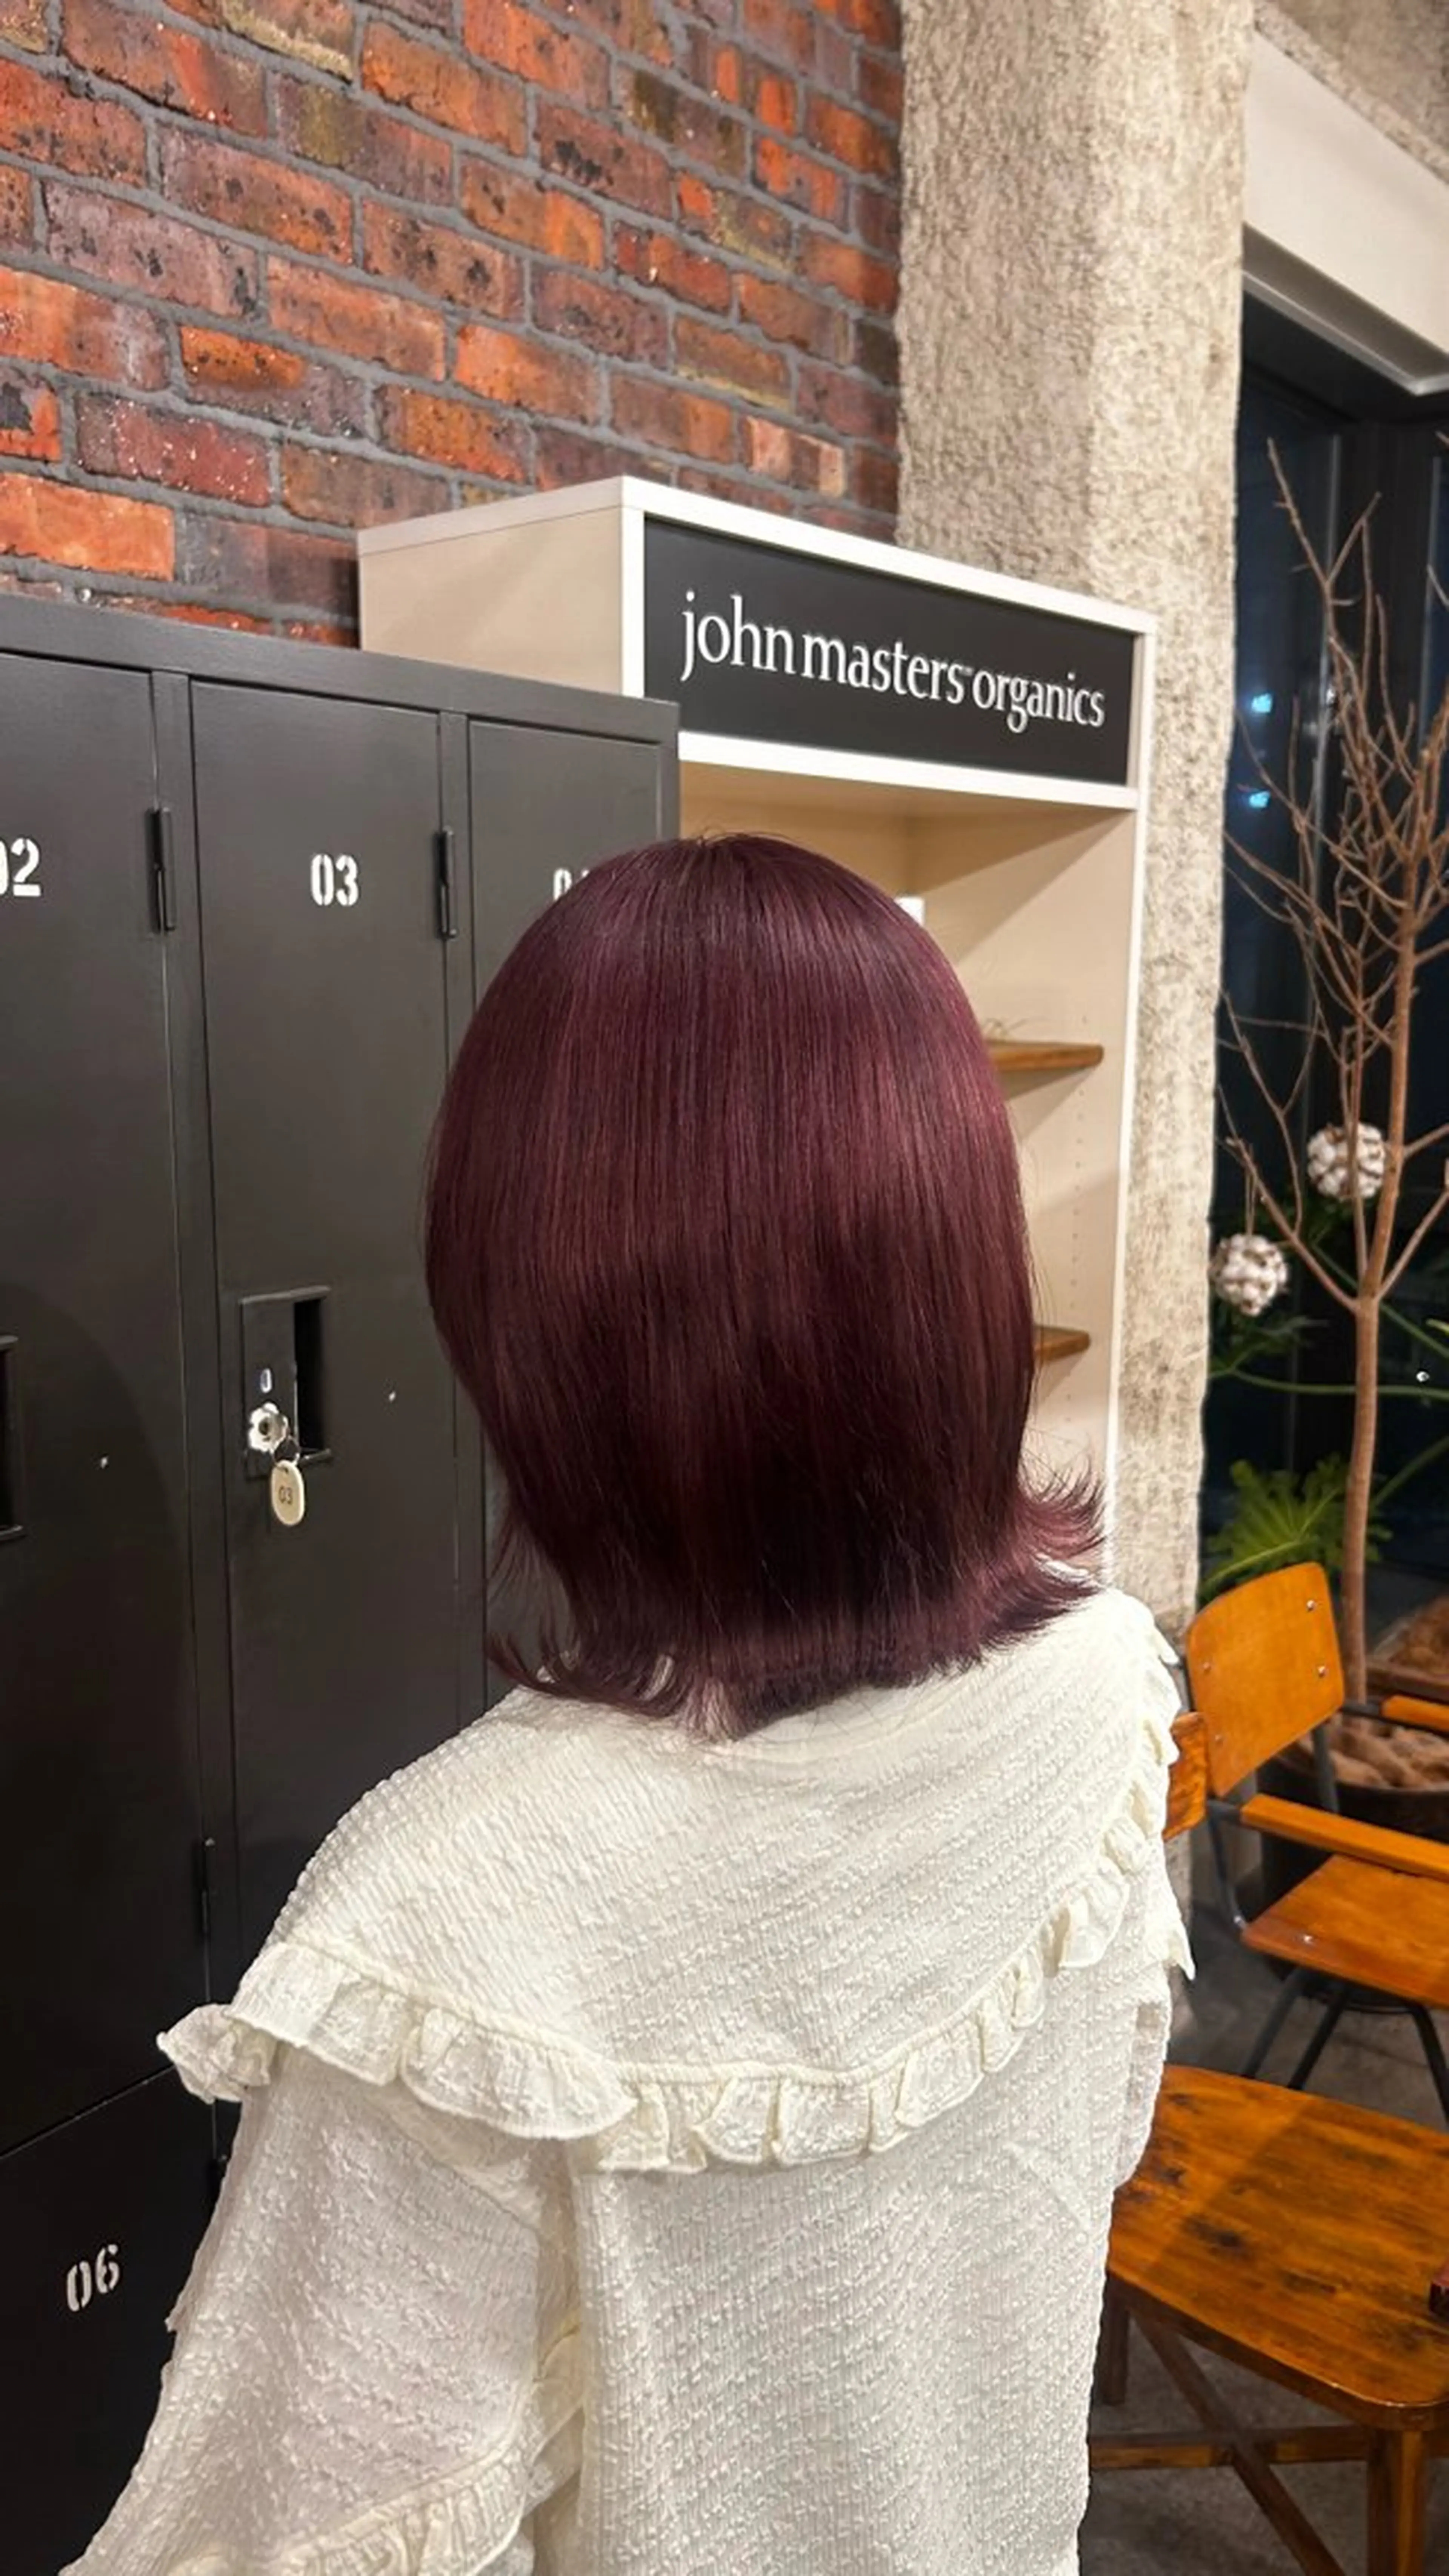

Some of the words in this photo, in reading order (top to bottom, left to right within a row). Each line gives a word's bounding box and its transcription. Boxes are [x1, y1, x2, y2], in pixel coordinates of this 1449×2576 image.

[680, 589, 796, 681] john
[972, 670, 1104, 734] organics
[310, 853, 359, 907] 03
[278, 1485, 293, 1505] 03
[67, 2244, 119, 2311] 06
